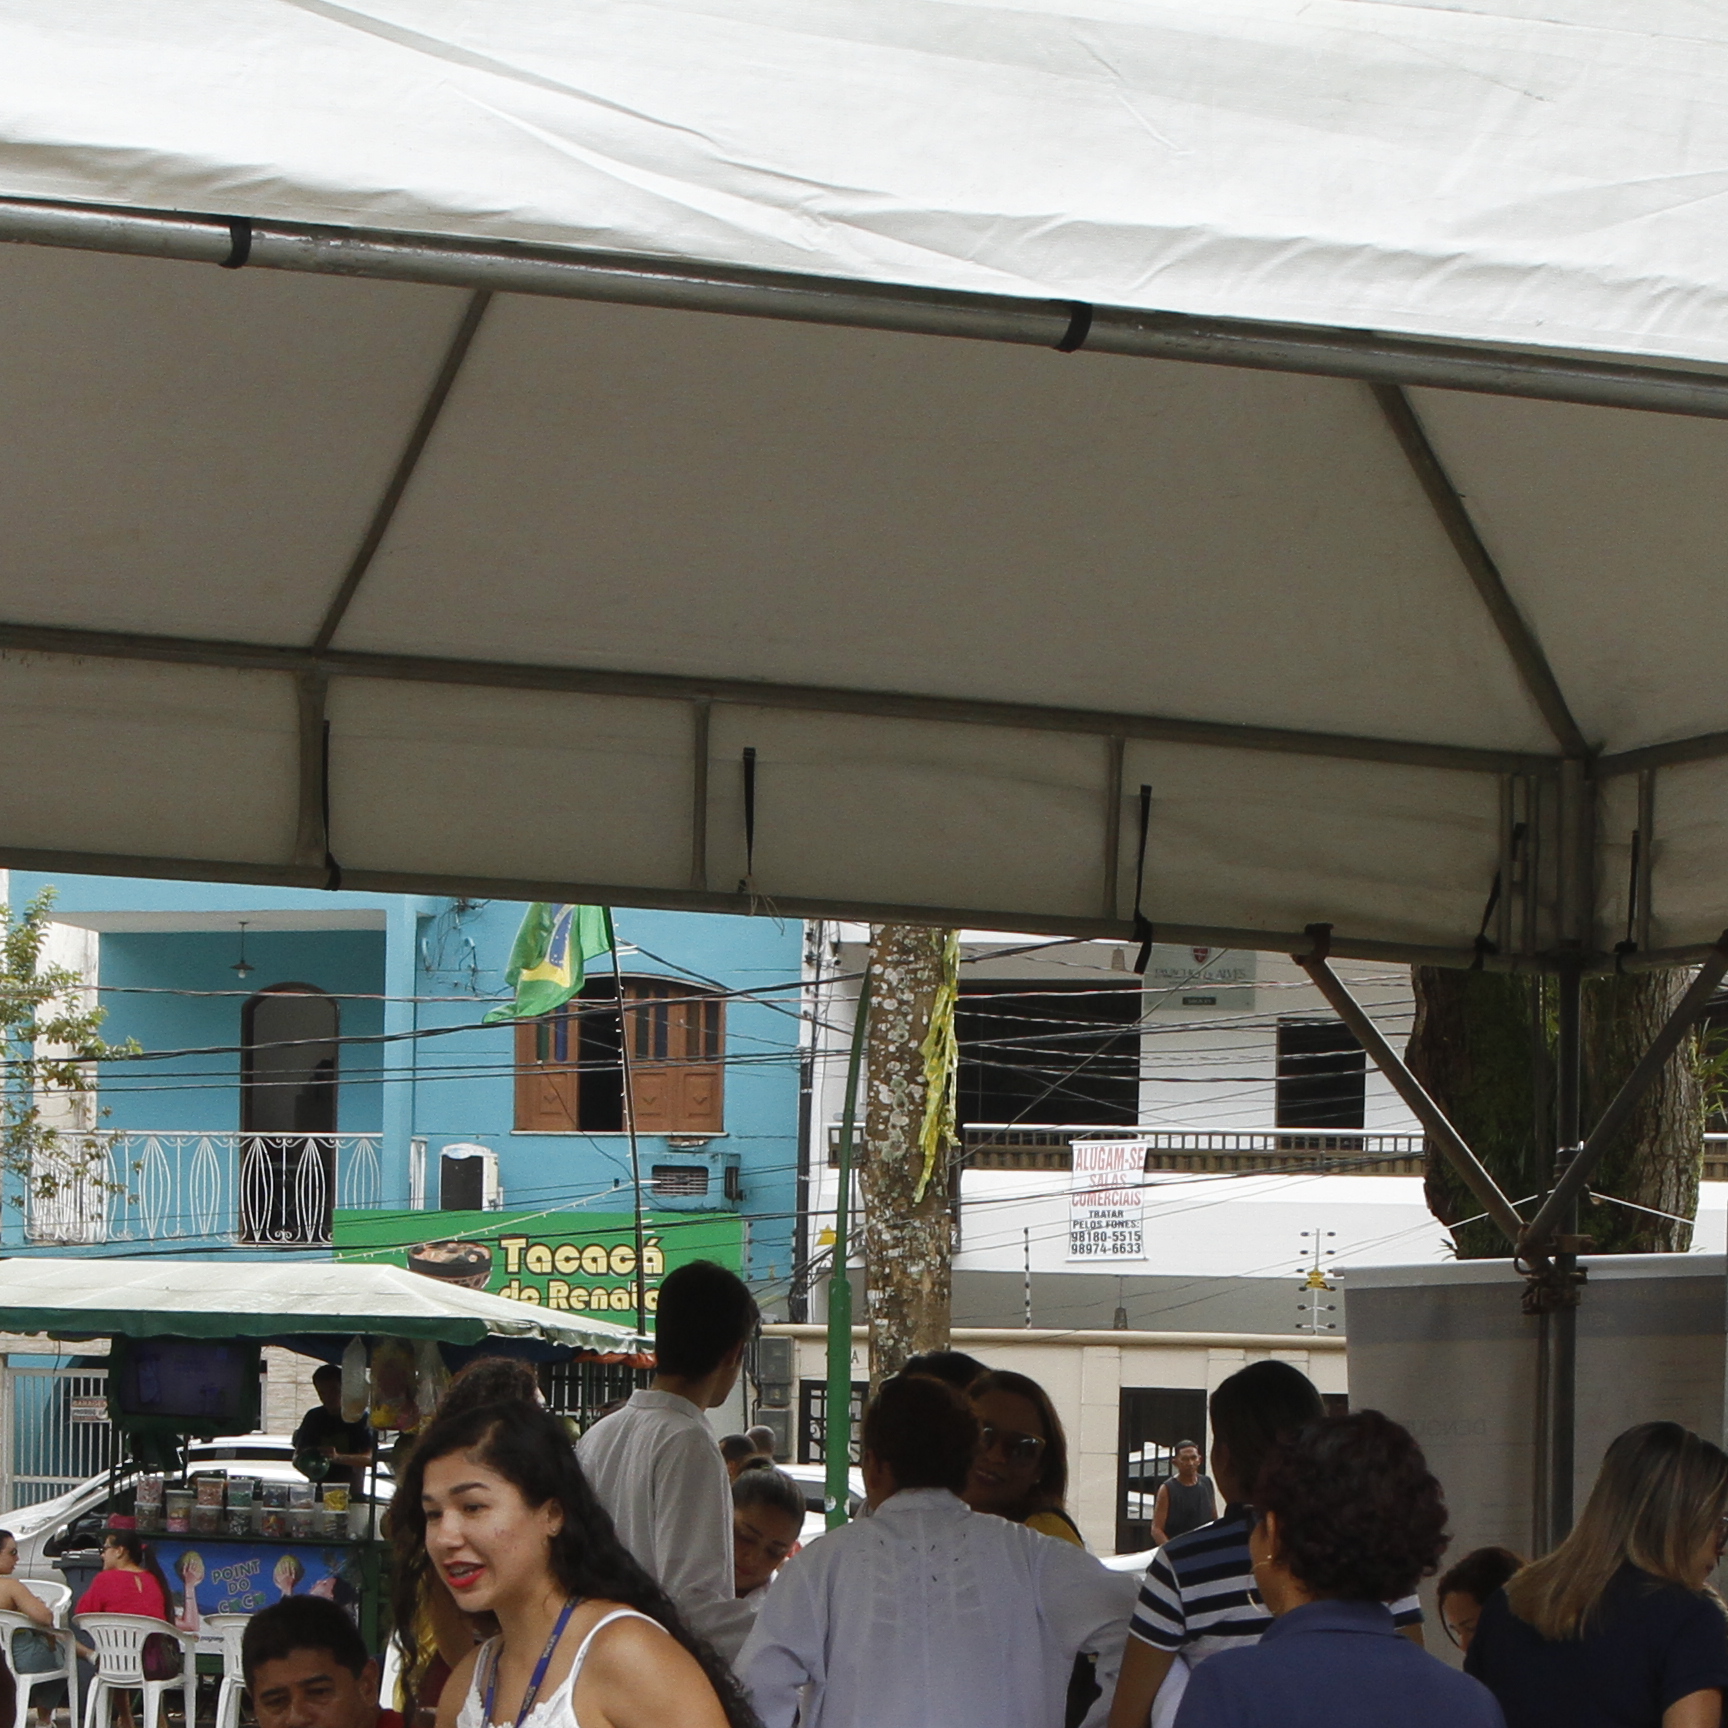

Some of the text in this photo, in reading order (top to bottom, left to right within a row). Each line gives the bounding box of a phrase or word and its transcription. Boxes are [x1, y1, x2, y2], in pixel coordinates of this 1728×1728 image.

[1075, 1146, 1144, 1171] ALUGAM-SE
[1089, 1174, 1127, 1188] SALAS
[1072, 1191, 1141, 1207] COMERCIAIS
[1089, 1210, 1124, 1218] TRATAR
[1073, 1219, 1140, 1229] PELOS FONES:
[1072, 1231, 1141, 1243] 98180-5515
[498, 1234, 665, 1277] Tacacá
[1072, 1243, 1141, 1255] 98974-6633
[498, 1279, 660, 1311] do Renato
[211, 1558, 261, 1585] POINT
[227, 1578, 251, 1595] DO
